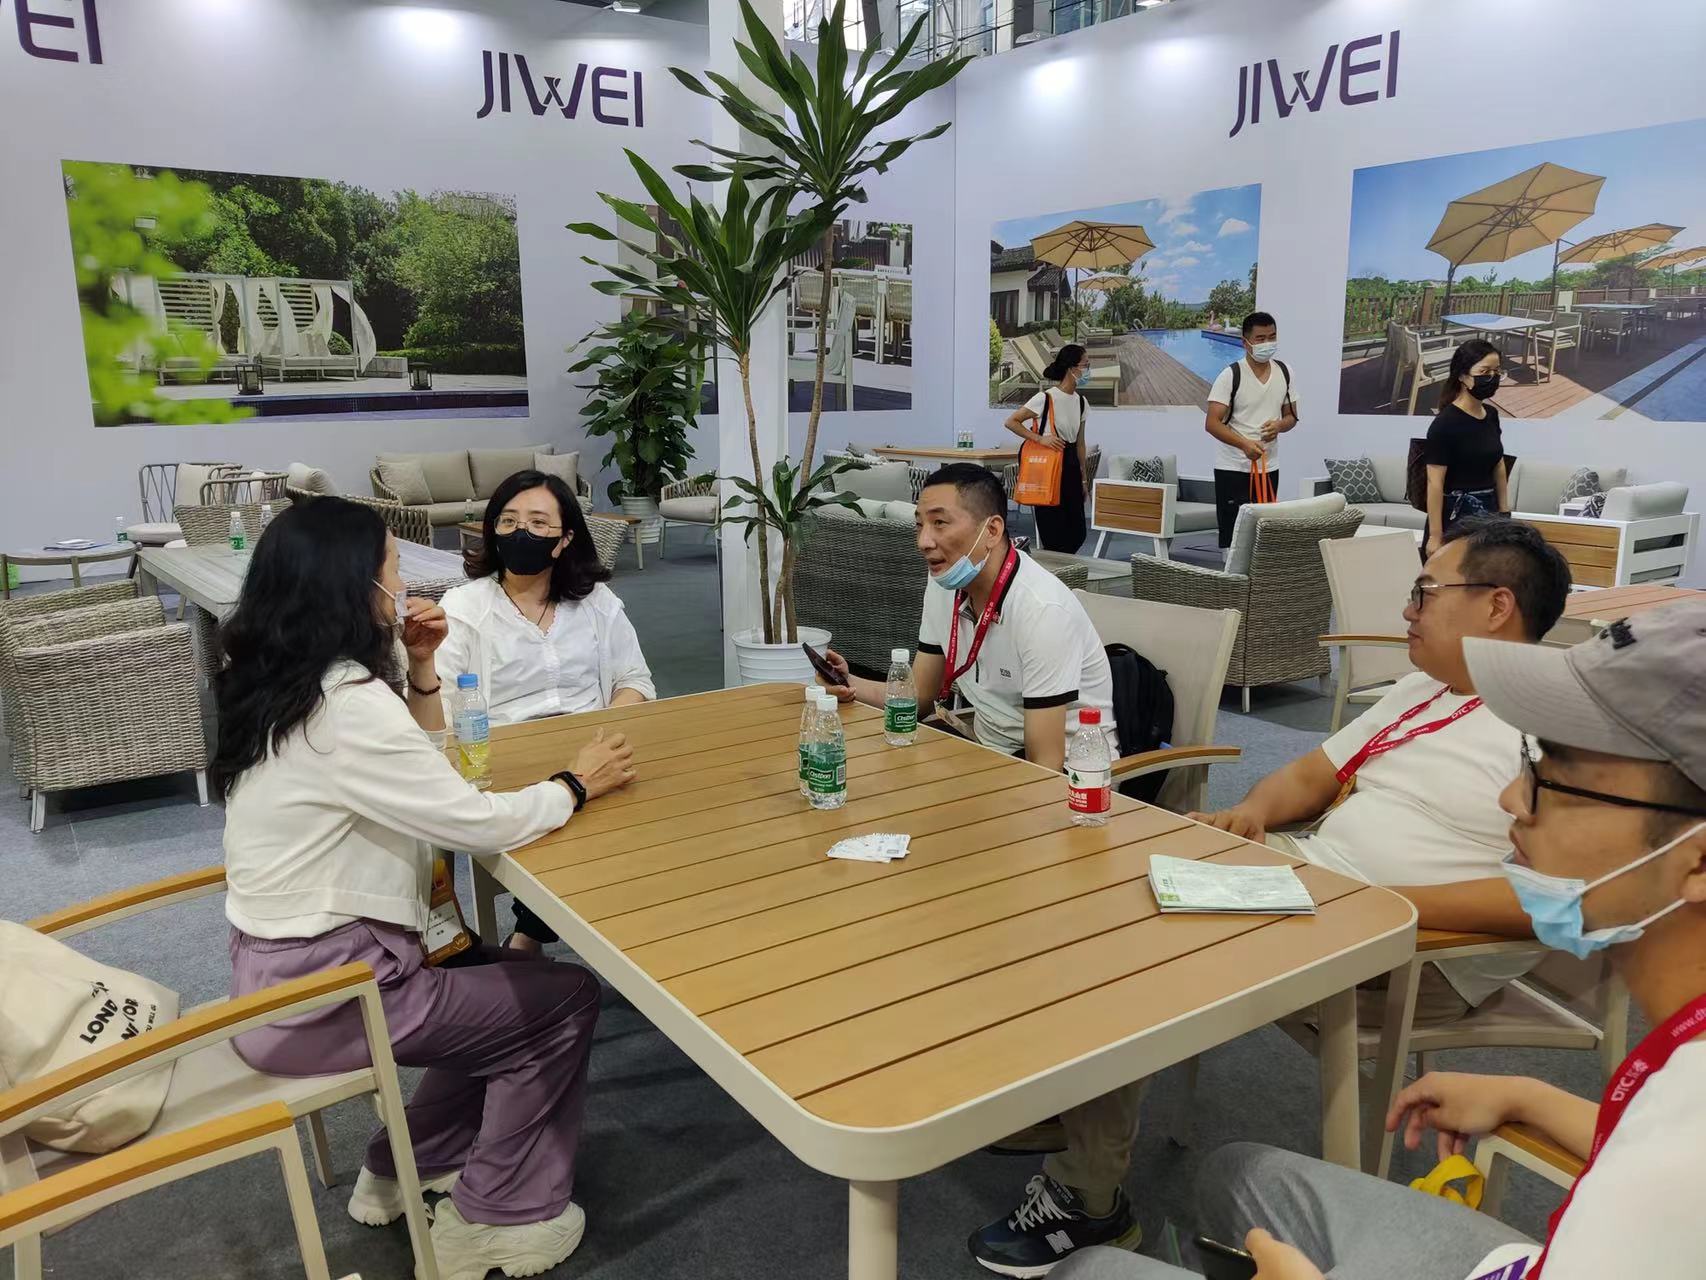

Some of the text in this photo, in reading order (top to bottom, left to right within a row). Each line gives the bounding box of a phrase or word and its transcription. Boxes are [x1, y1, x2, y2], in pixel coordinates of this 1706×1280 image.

[0, 0, 103, 64] EI
[476, 49, 644, 128] JIWEI
[1229, 29, 1401, 138] JIWEI
[1610, 1075, 1635, 1102] DTC
